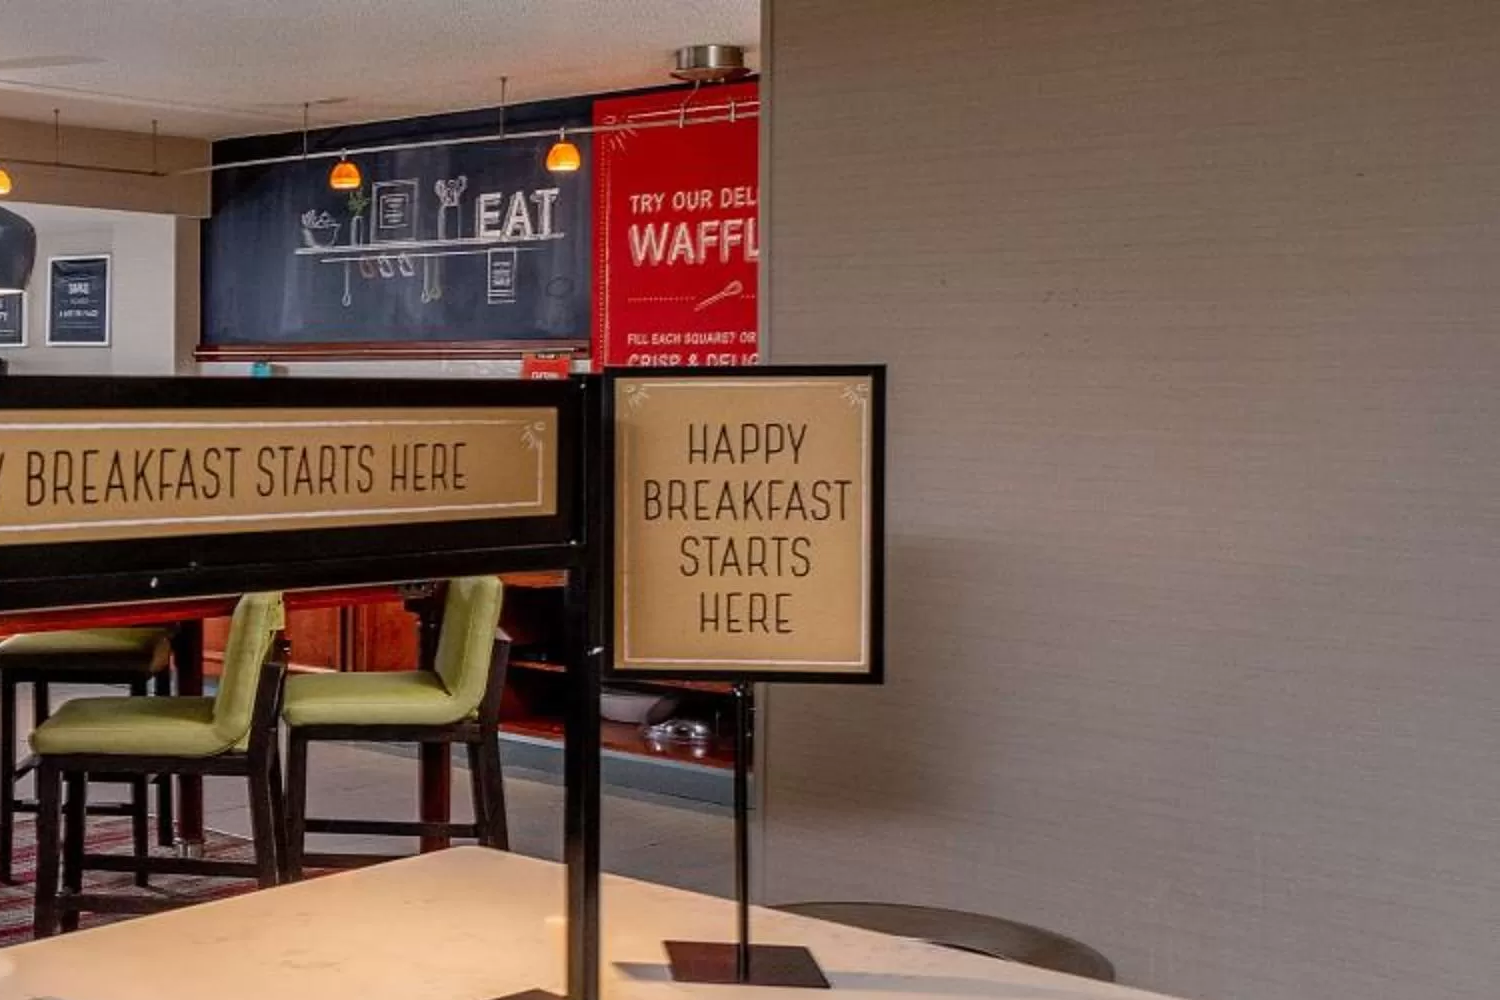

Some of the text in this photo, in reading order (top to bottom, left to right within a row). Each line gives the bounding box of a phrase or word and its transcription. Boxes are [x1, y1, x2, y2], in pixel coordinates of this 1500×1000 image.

[476, 187, 560, 239] EAT
[629, 186, 759, 214] TRY OUR DEL
[627, 217, 760, 267] WAFFL
[651, 332, 681, 345] EACH
[688, 423, 808, 465] HAPPY
[26, 447, 241, 507] BREAKFAST
[256, 444, 375, 498] STARTS
[390, 442, 467, 492] HERE
[644, 479, 852, 522] BREAKFAST
[679, 535, 812, 578] STARTS
[699, 591, 793, 634] HERE
